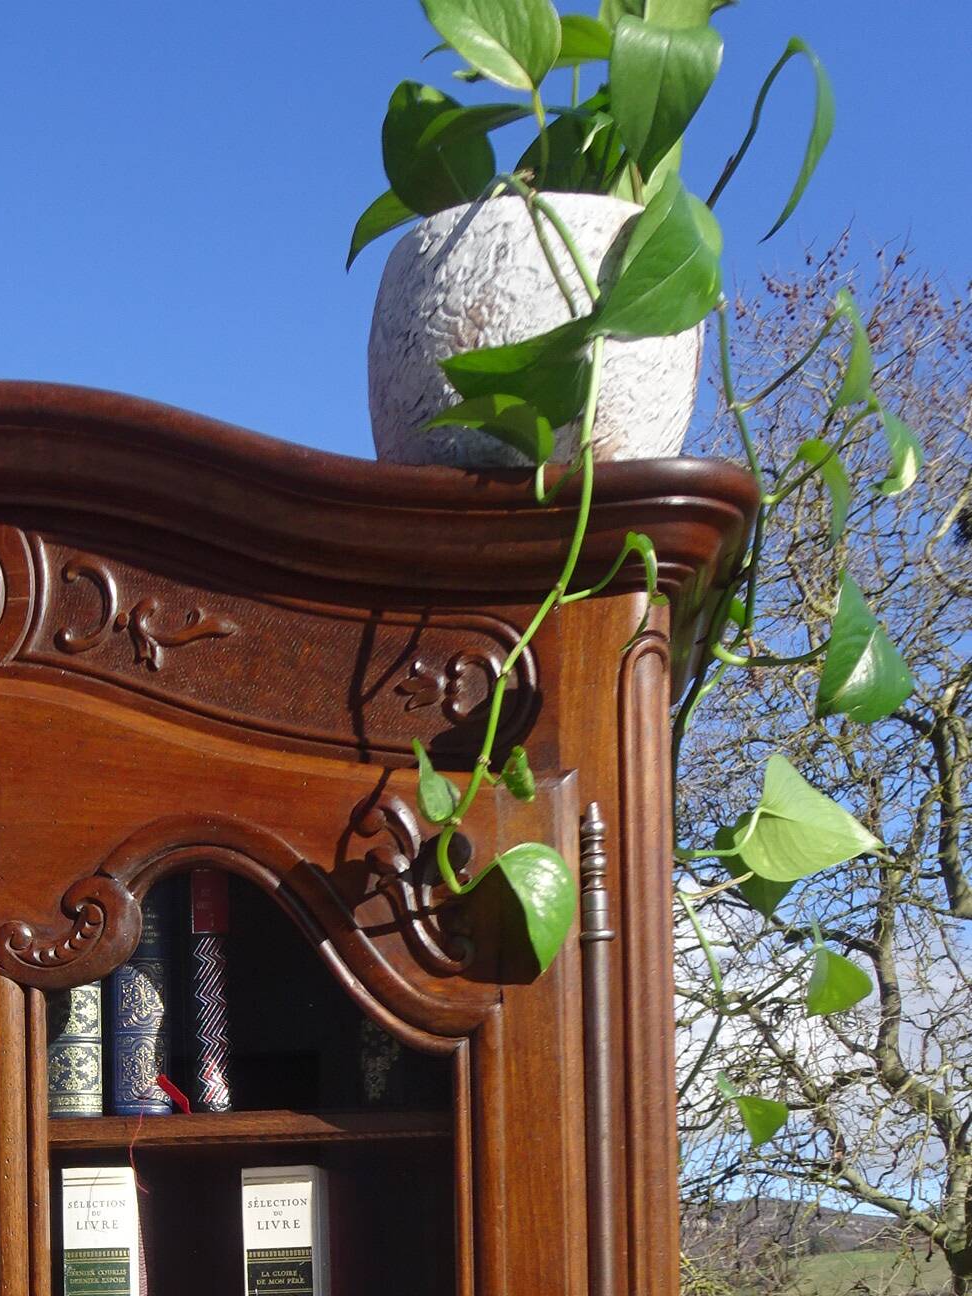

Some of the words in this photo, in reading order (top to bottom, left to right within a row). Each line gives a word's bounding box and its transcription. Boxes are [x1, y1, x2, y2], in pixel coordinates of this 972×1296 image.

[67, 1199, 126, 1209] SÉLECTION
[247, 1197, 308, 1209] SÉLECTION
[75, 1220, 120, 1231] LIVRE
[257, 1219, 301, 1231] LIVRE
